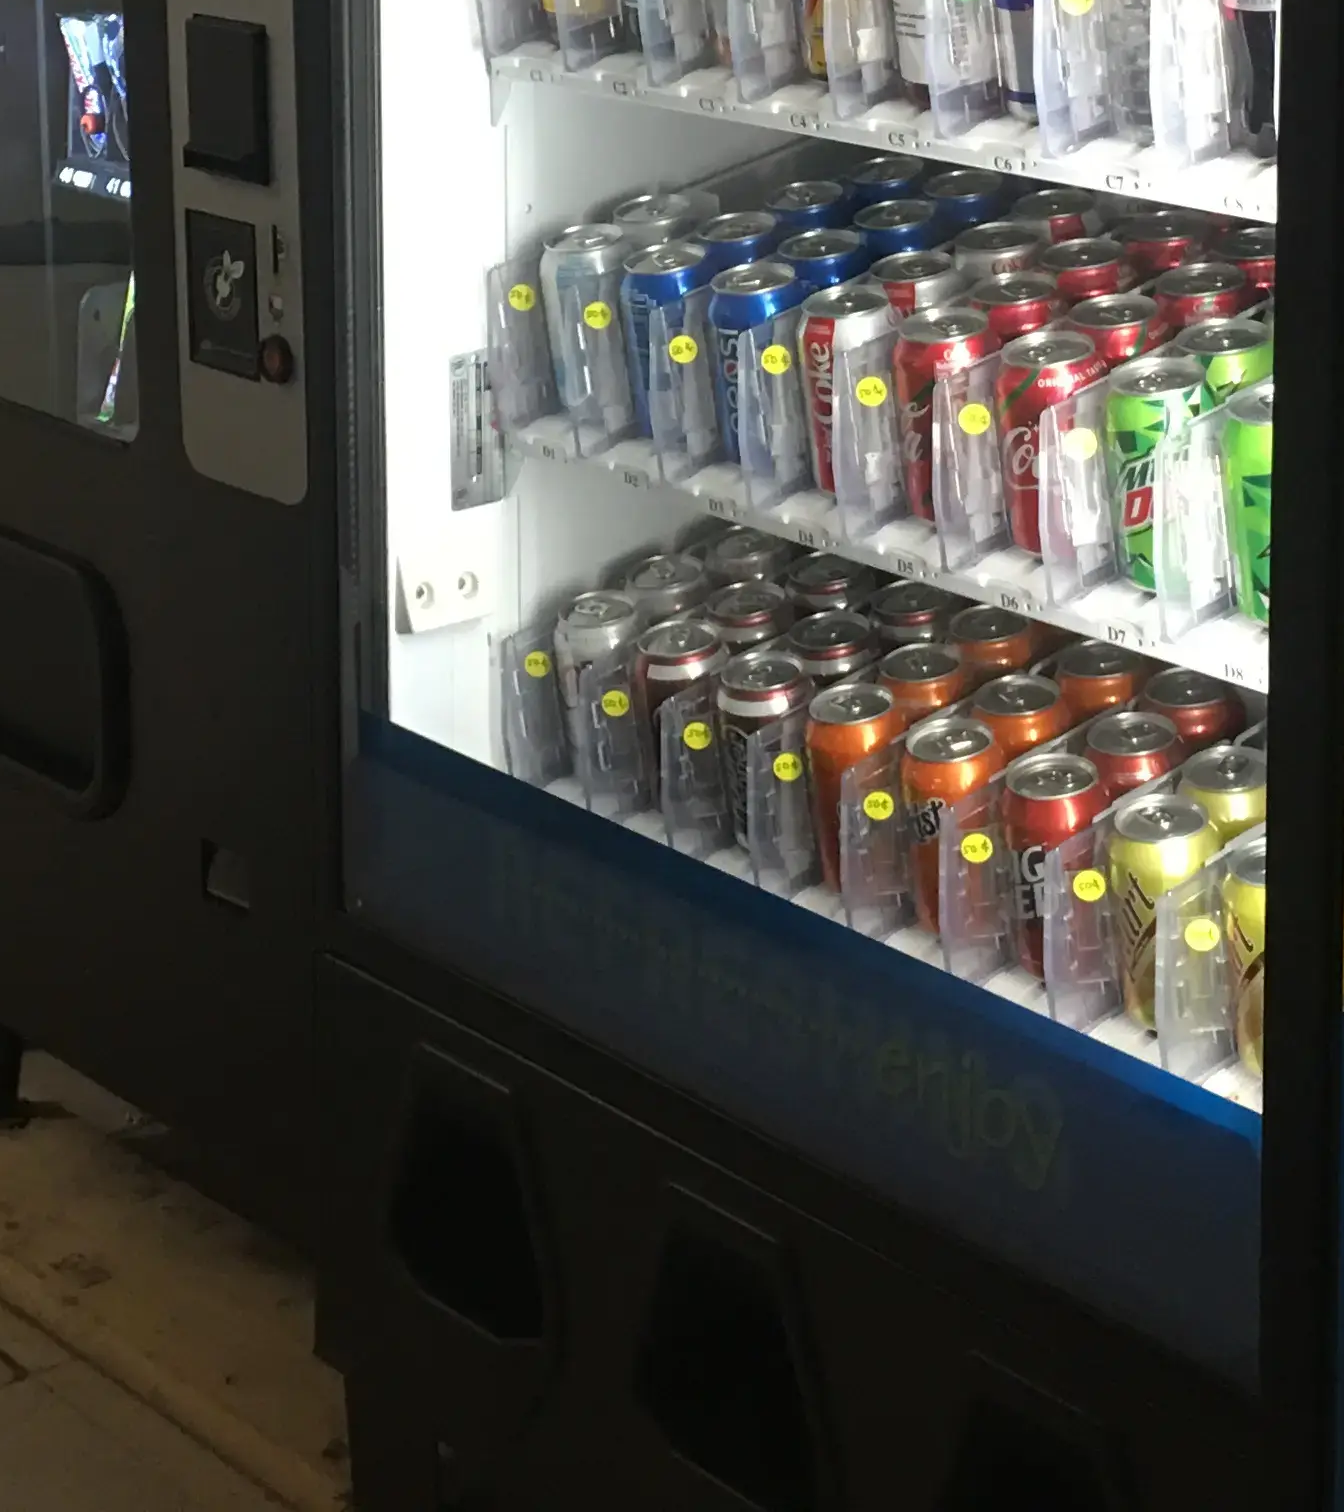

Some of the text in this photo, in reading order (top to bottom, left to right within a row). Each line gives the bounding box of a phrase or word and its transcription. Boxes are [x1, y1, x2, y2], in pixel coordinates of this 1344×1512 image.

[789, 113, 806, 128] C4
[888, 131, 905, 147] C5
[994, 155, 1012, 171] C6
[1105, 174, 1124, 190] C7
[897, 558, 914, 574] D5
[1001, 593, 1019, 610] D6
[1108, 626, 1126, 644] D7
